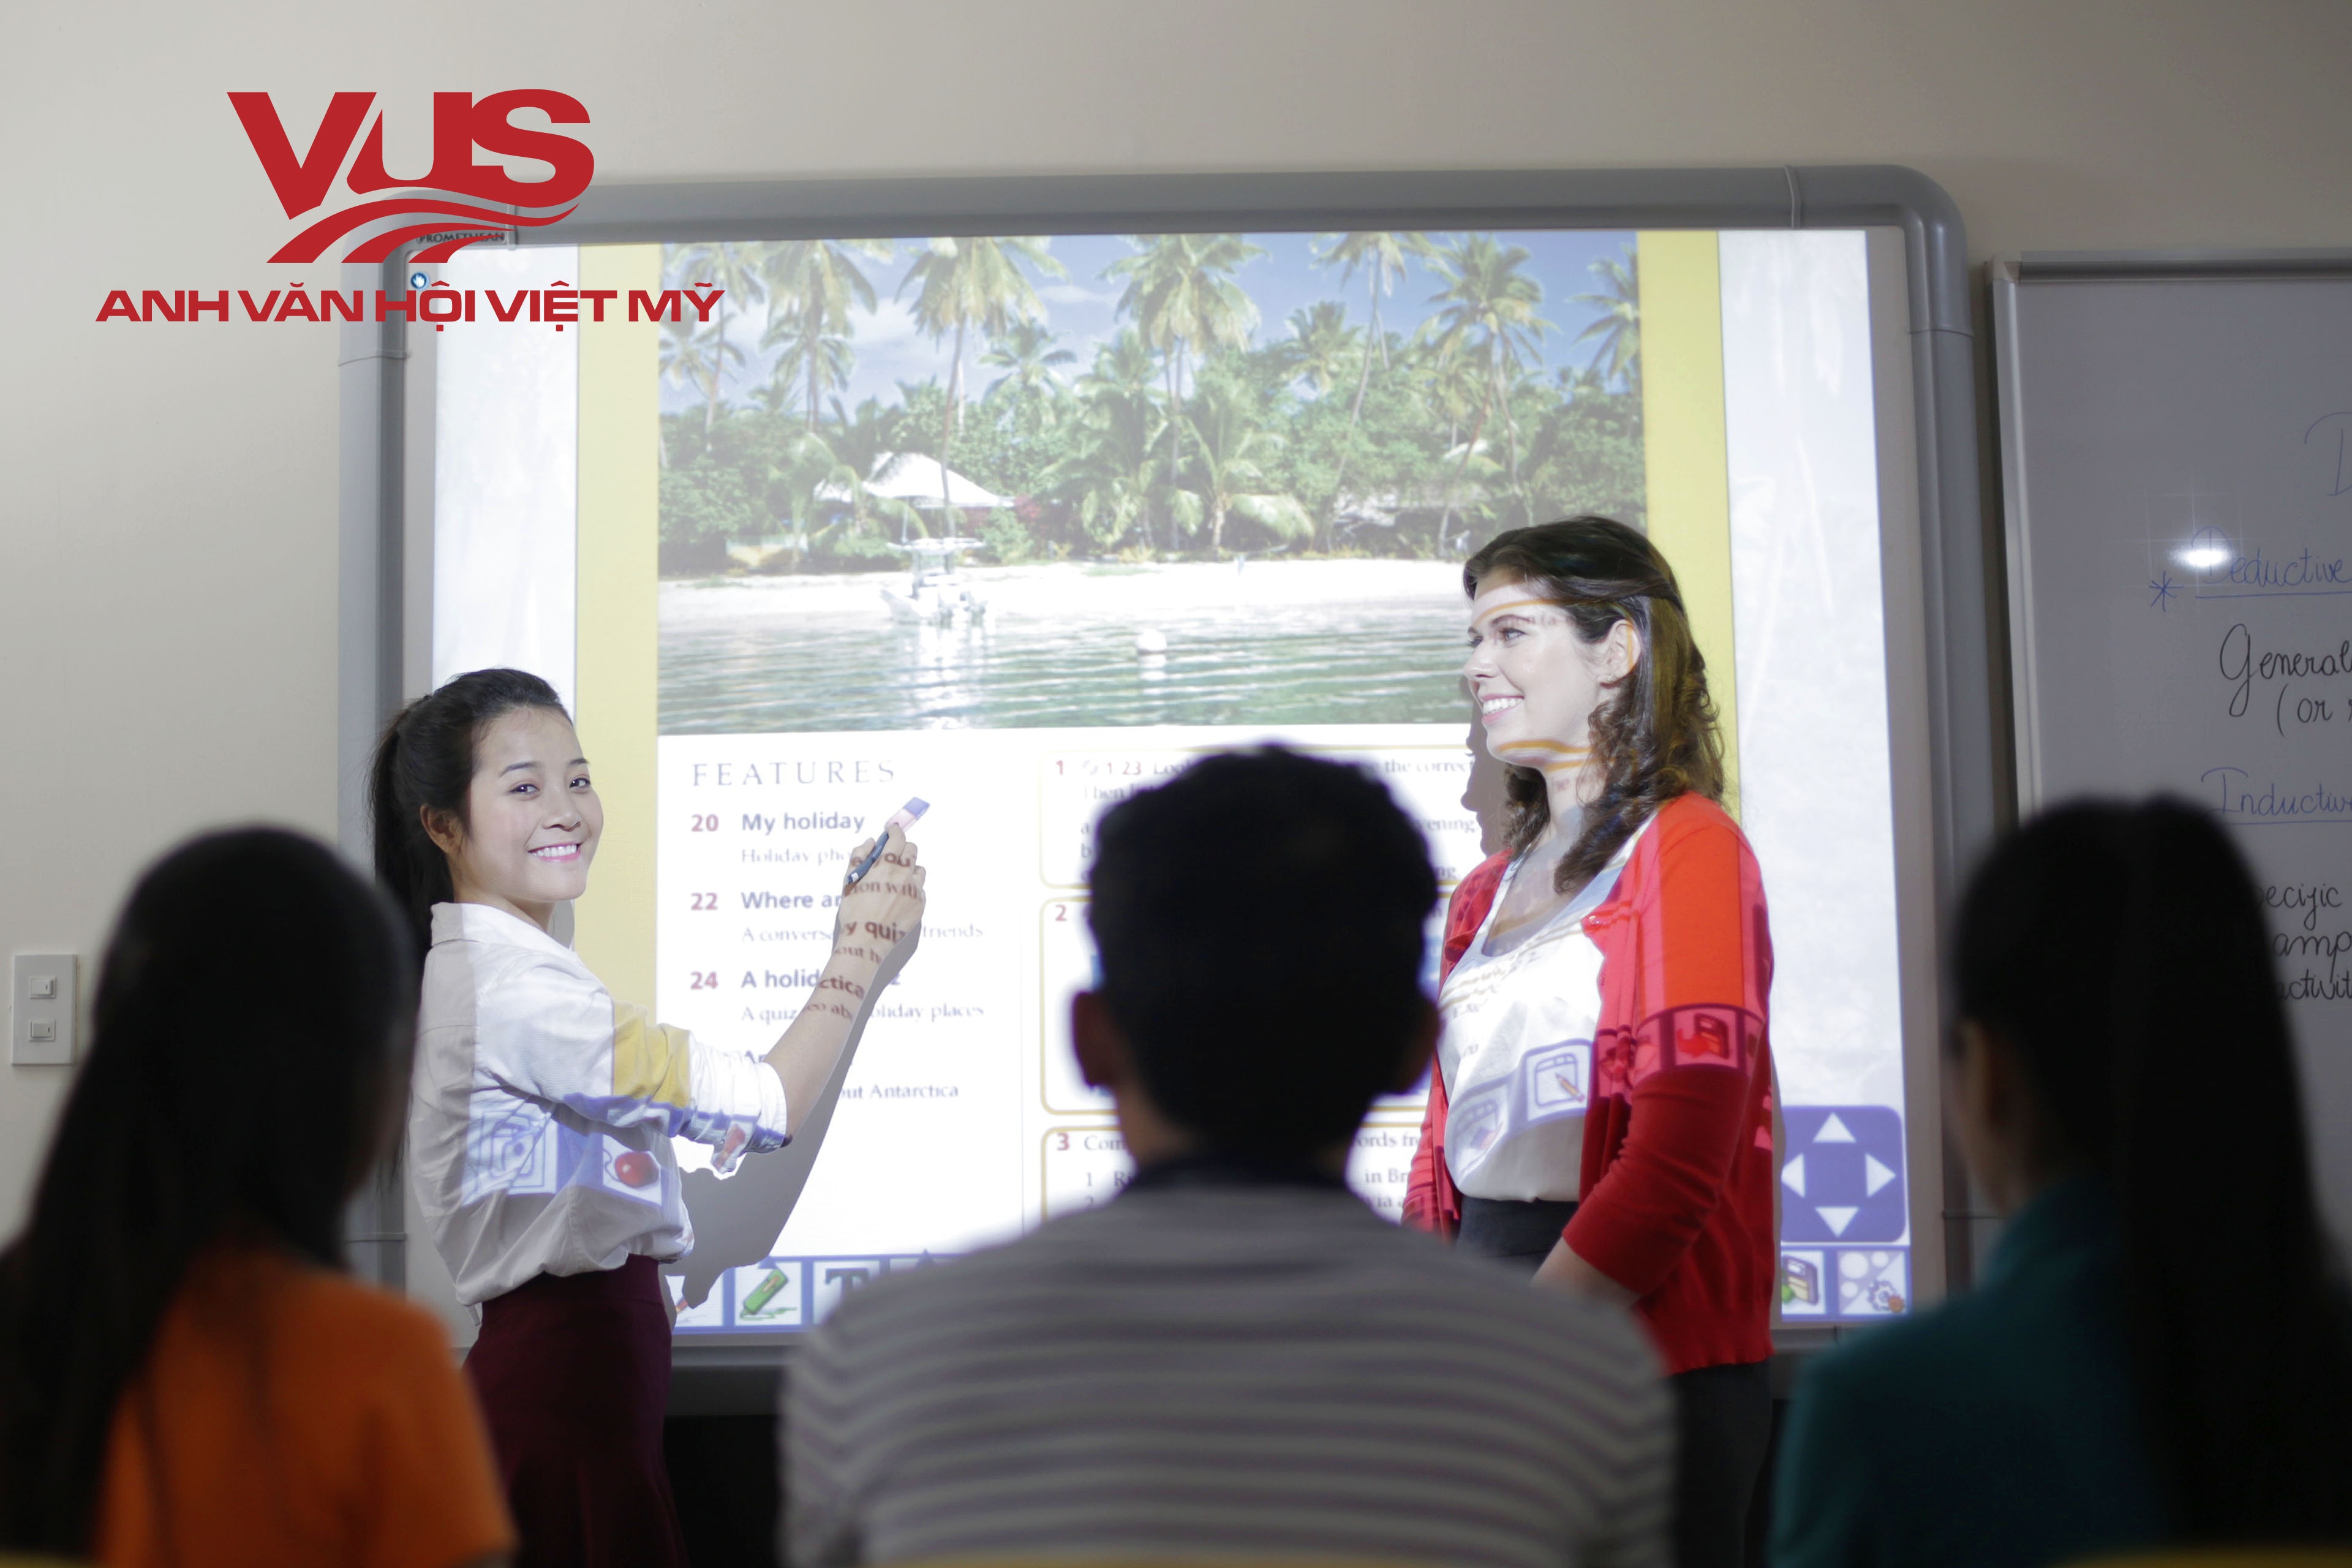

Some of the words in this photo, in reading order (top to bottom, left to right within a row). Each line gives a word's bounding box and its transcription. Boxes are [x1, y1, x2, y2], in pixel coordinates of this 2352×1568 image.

[2277, 683, 2334, 737] (or
[692, 760, 895, 786] FEATURES
[1384, 759, 1411, 773] the
[690, 814, 719, 832] 20
[741, 813, 775, 835] My
[783, 812, 865, 833] holiday
[741, 849, 810, 864] Holiday
[690, 892, 719, 911] 22
[741, 890, 813, 910] Where
[1055, 905, 1067, 921] 2
[741, 925, 755, 943] A
[690, 971, 718, 990] 24
[741, 971, 758, 989] A
[741, 1008, 755, 1022] A
[759, 1008, 798, 1026] quiz
[930, 1002, 985, 1022] places
[869, 1084, 959, 1101] Antarctica
[1057, 1132, 1070, 1151] 3
[1365, 1167, 1382, 1183] in
